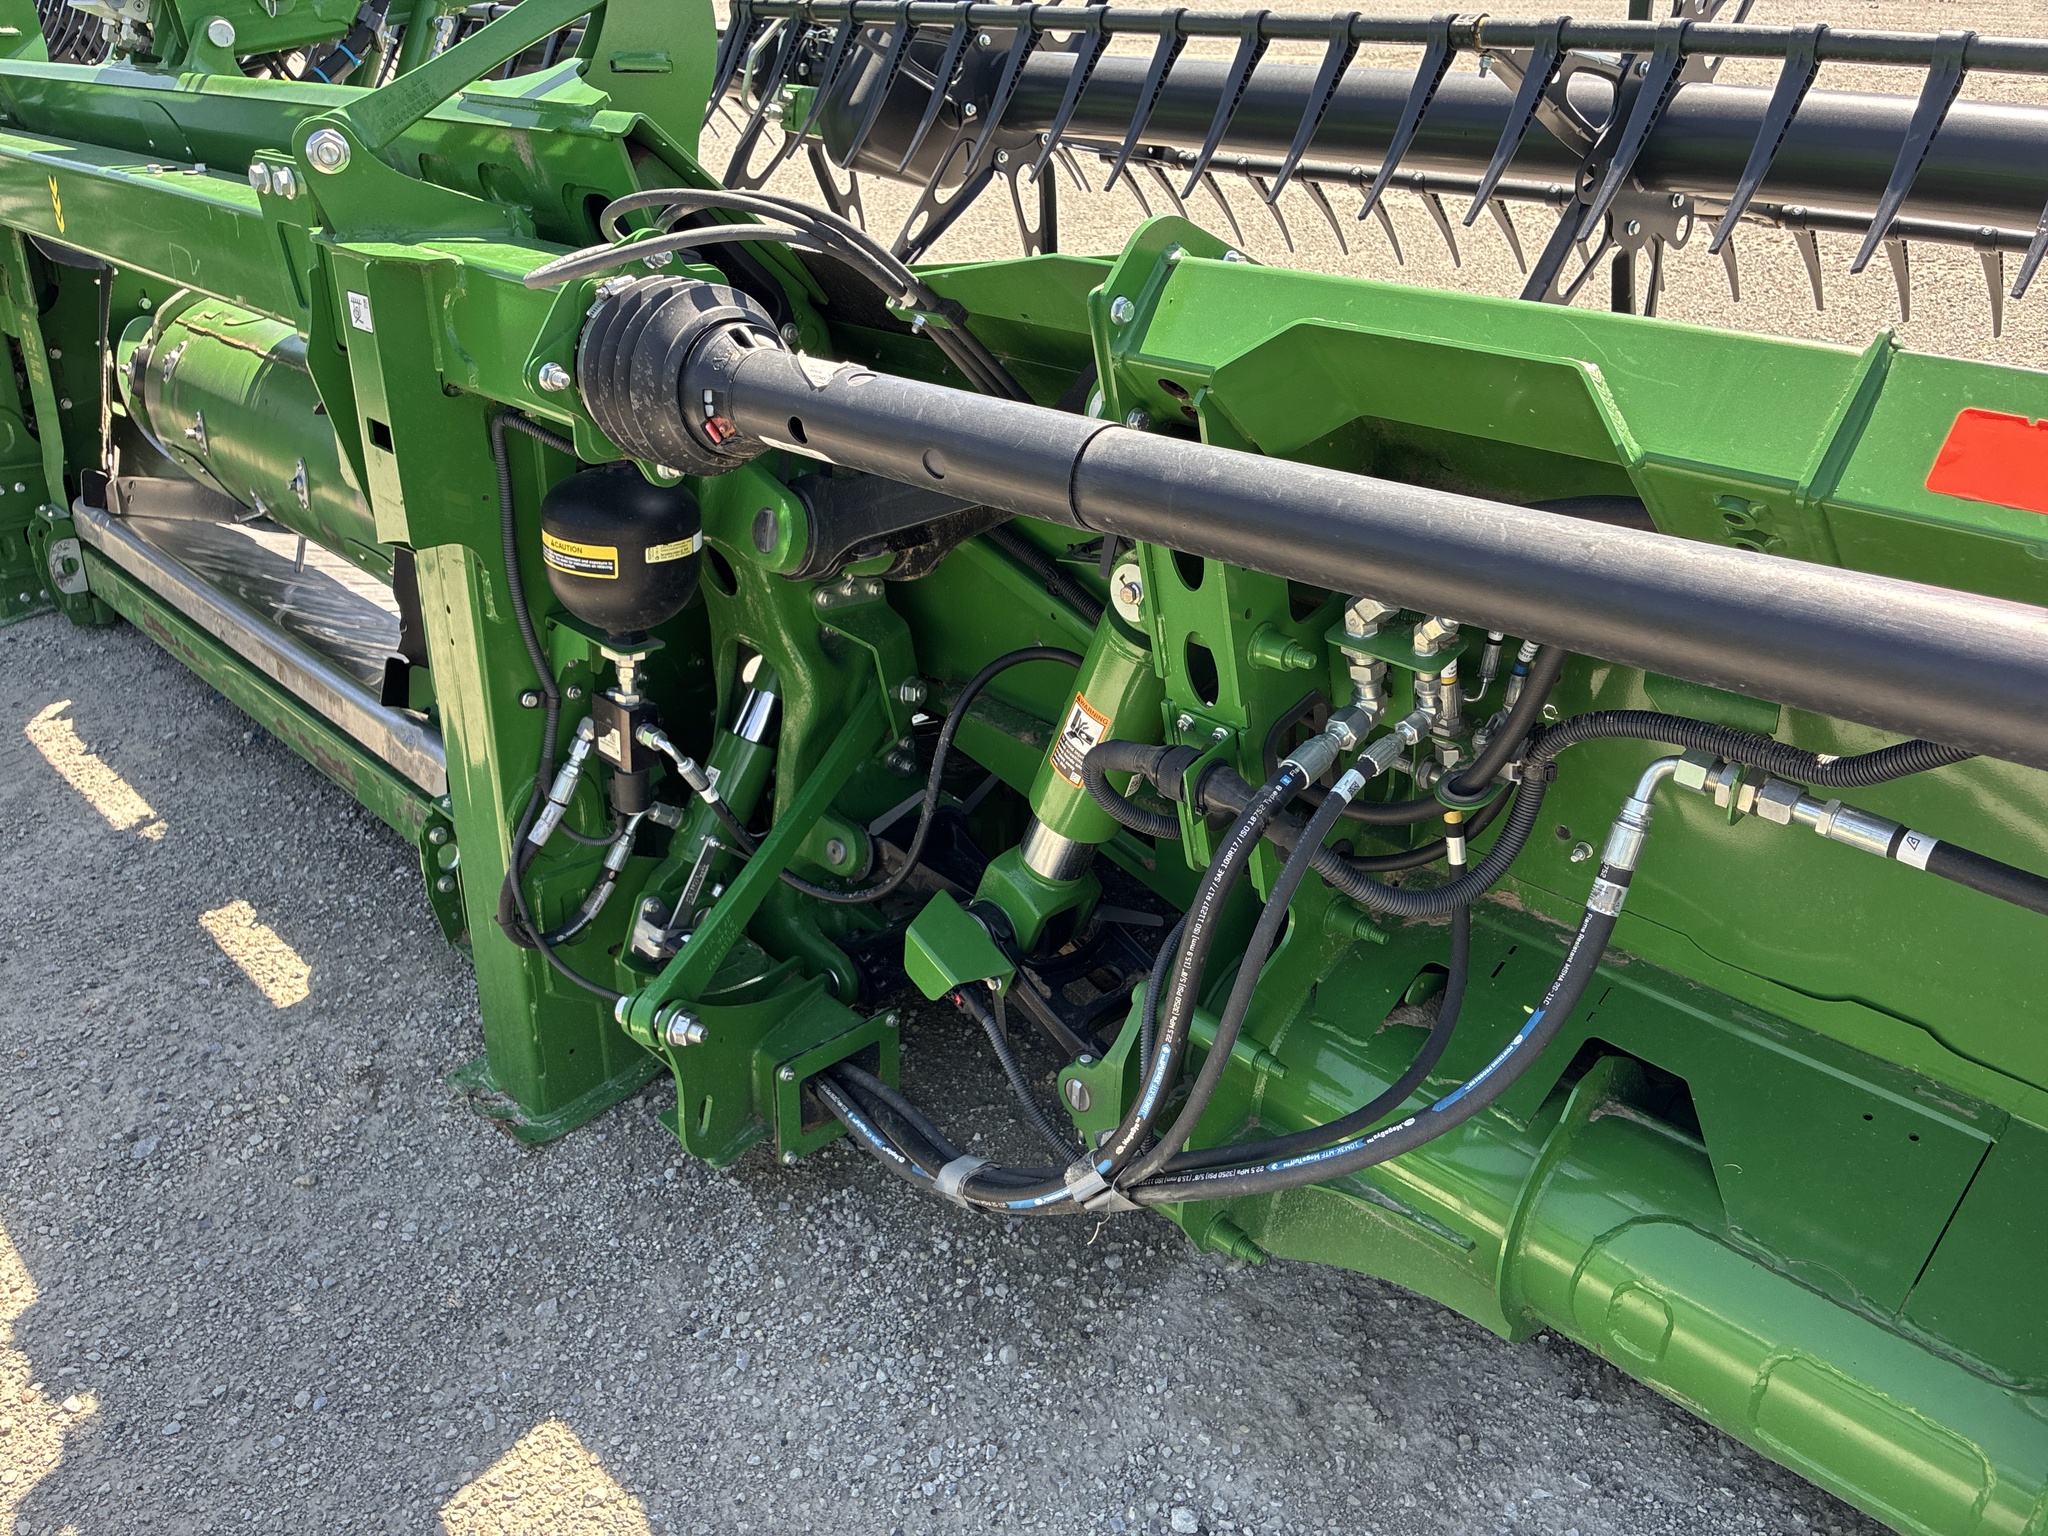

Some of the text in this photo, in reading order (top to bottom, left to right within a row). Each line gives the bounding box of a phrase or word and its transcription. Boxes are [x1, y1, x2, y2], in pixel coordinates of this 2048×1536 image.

[554, 541, 583, 554] CAUTION
[1079, 700, 1109, 725] WARNING
[1262, 789, 1279, 806] Type
[1246, 803, 1267, 826] 18752
[1238, 824, 1251, 839] ISO
[1219, 840, 1240, 870] 100R17
[1213, 866, 1225, 883] SAE
[1205, 886, 1217, 901] R17
[1196, 900, 1211, 923] 11237
[1192, 922, 1203, 936] ISO
[1578, 912, 1593, 934] Flame
[1565, 932, 1585, 963] Resistant
[1556, 962, 1570, 982] MSHA
[1168, 1014, 1178, 1029] MPa
[1164, 1028, 1174, 1043] 22.5
[1319, 1140, 1359, 1158] 10M3K-MTF
[1235, 1167, 1250, 1175] MPa
[1250, 1165, 1265, 1173] 22.5
